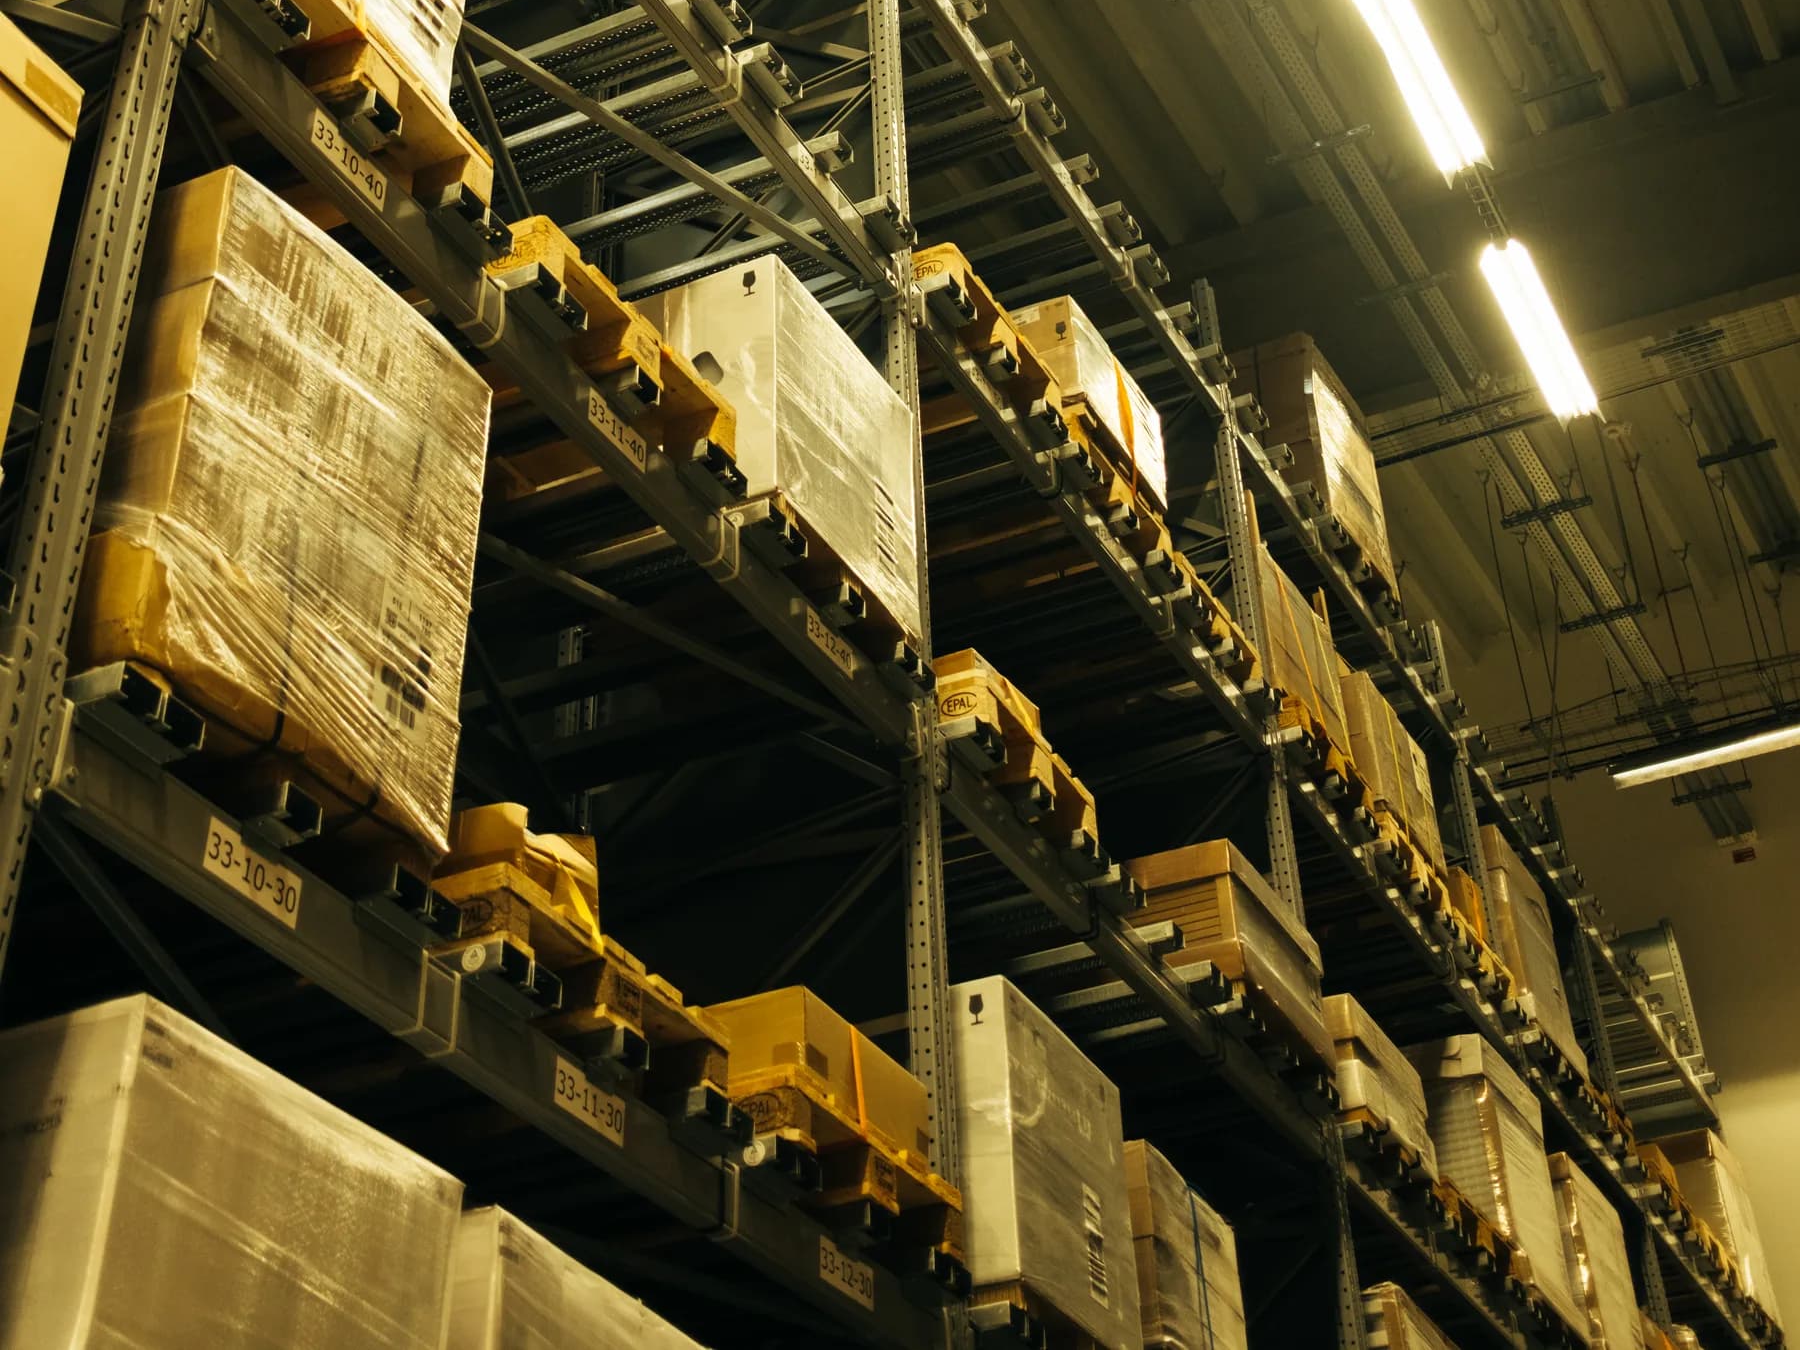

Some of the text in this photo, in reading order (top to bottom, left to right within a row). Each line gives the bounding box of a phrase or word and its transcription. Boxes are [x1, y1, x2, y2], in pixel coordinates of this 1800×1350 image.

[314, 119, 383, 200] 33-10-40
[916, 263, 939, 279] EPAL
[590, 397, 644, 463] 33-11-40
[808, 615, 852, 670] 33-12-40
[946, 695, 973, 713] EPAL
[208, 831, 297, 914] 33-10-30
[557, 1069, 623, 1134] 33-11-30
[821, 1246, 872, 1299] 33-12-30
